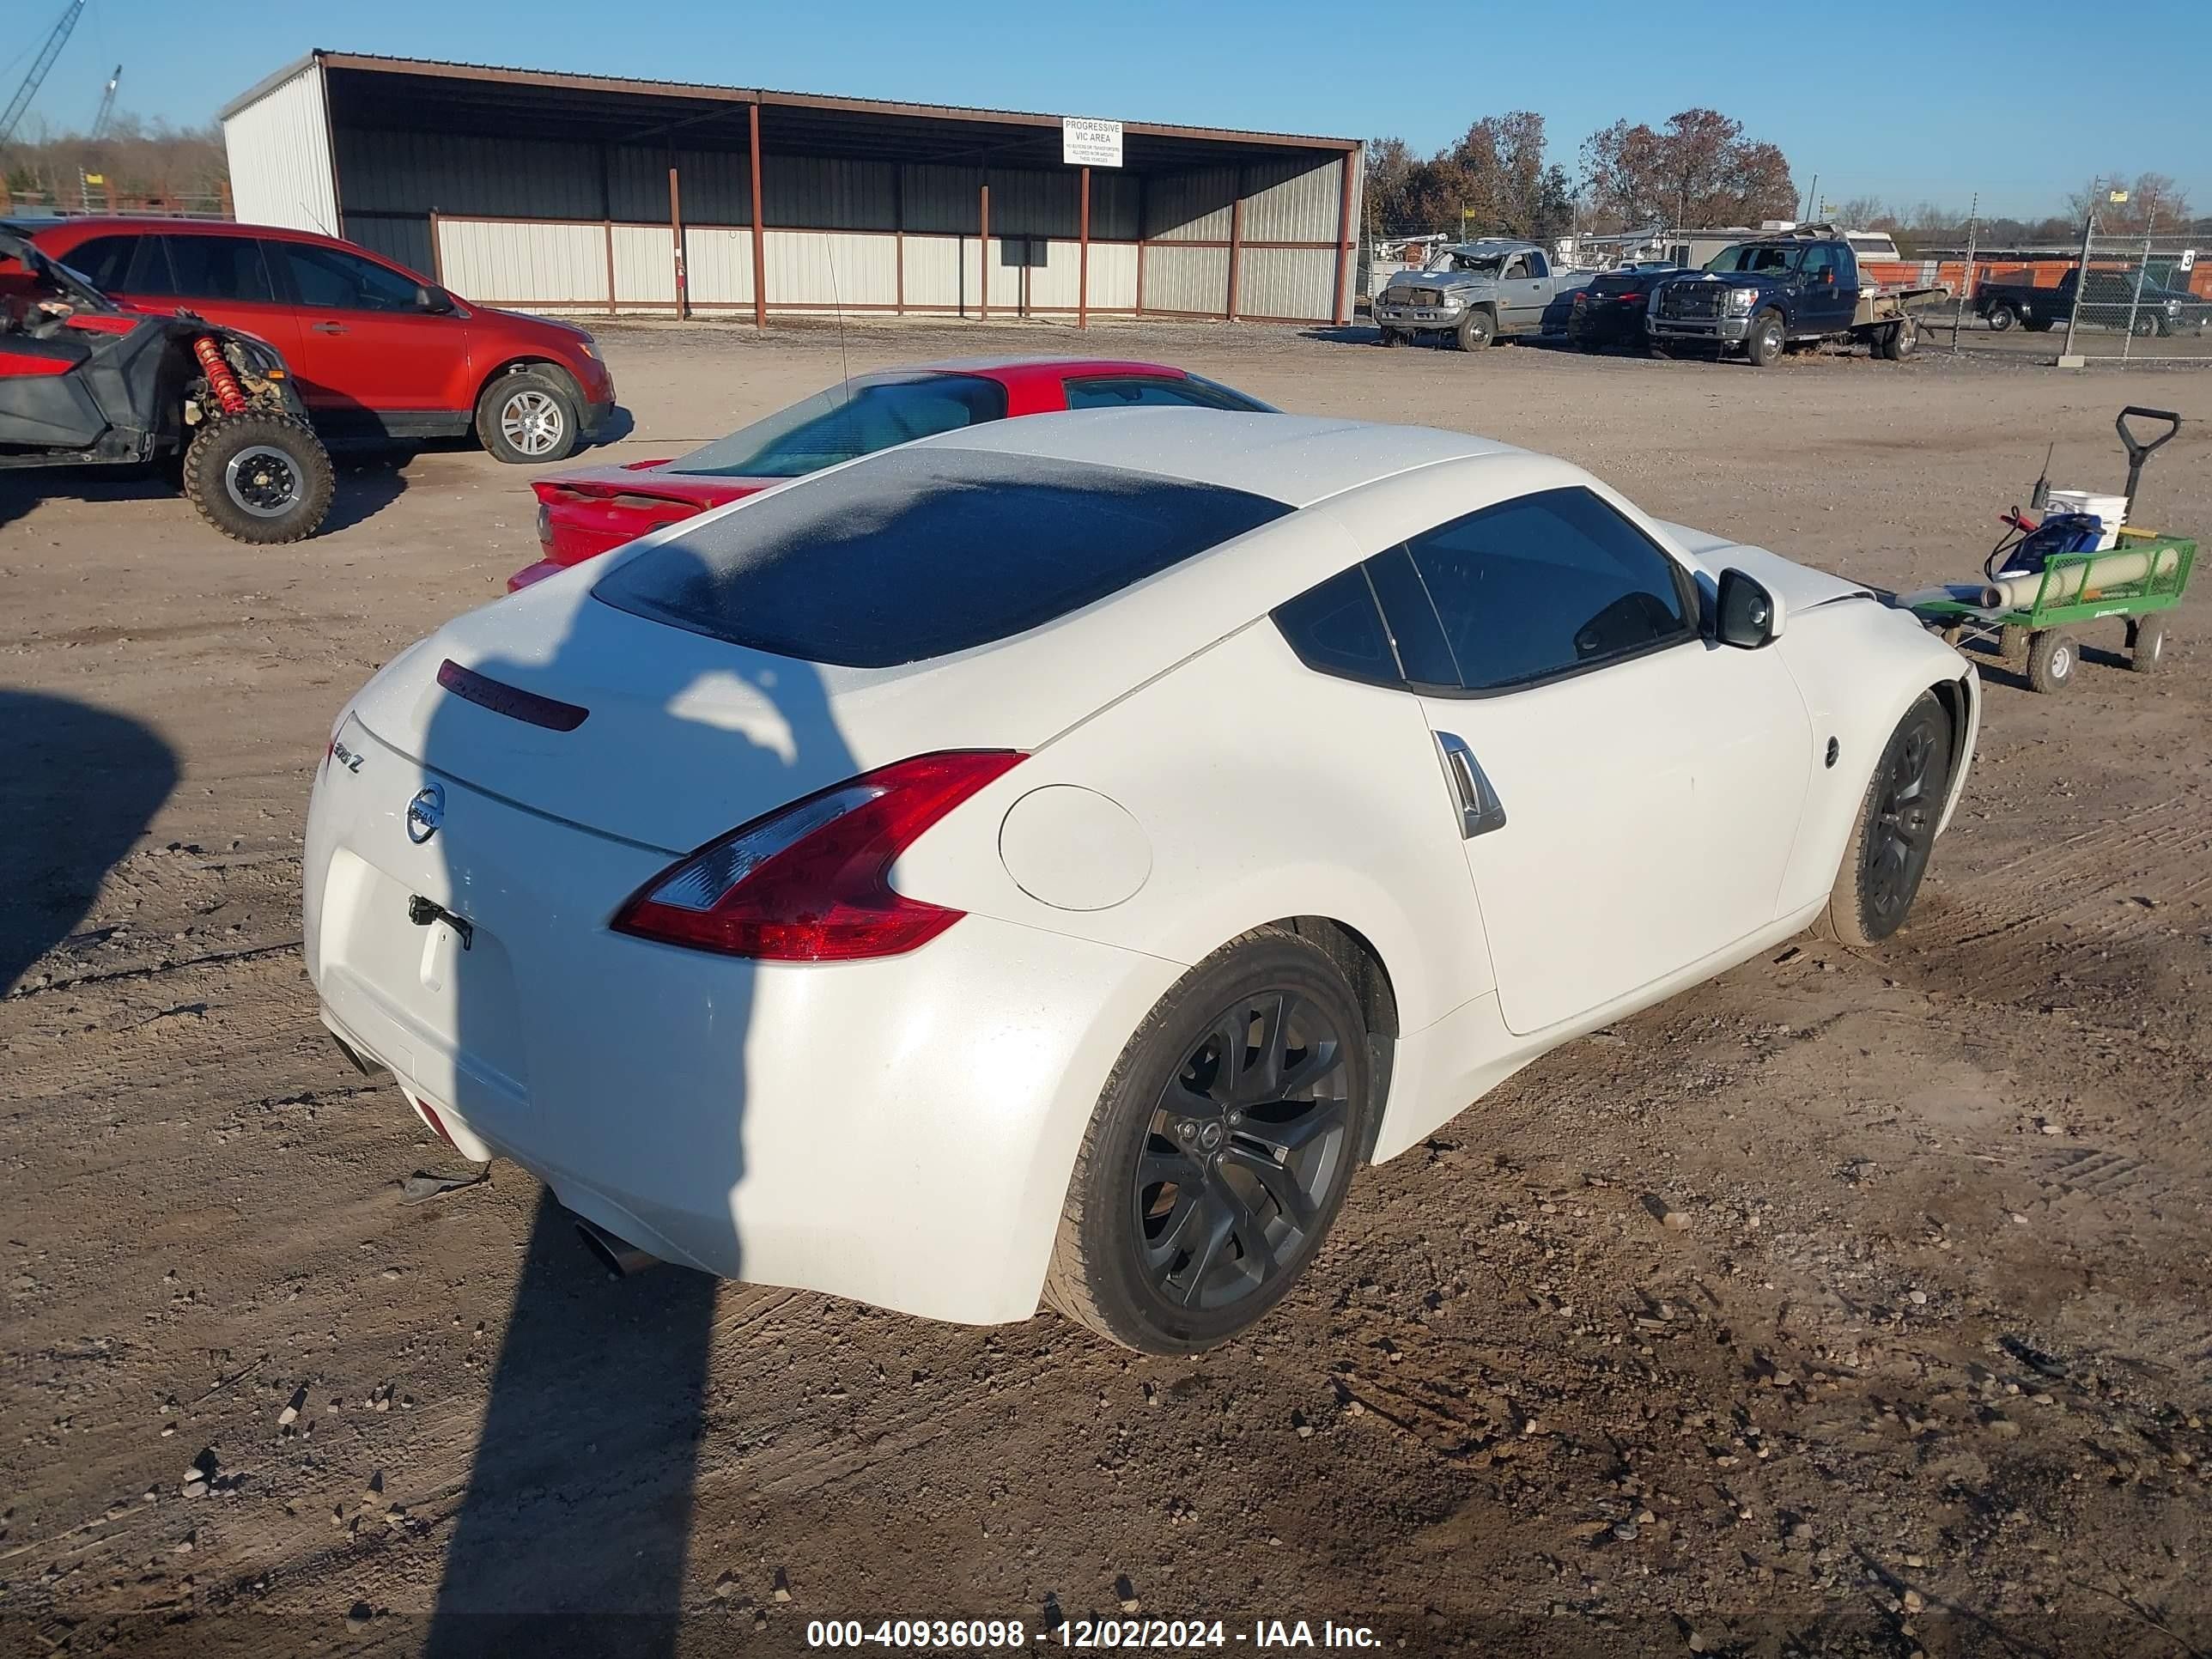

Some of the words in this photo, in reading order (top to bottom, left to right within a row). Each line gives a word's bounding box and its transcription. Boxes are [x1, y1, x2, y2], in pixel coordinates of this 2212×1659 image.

[1066, 120, 1120, 133] PROGRESSIVE
[1075, 131, 1088, 141] VIC
[1090, 133, 1111, 143] AREA
[2185, 254, 2192, 266] 3
